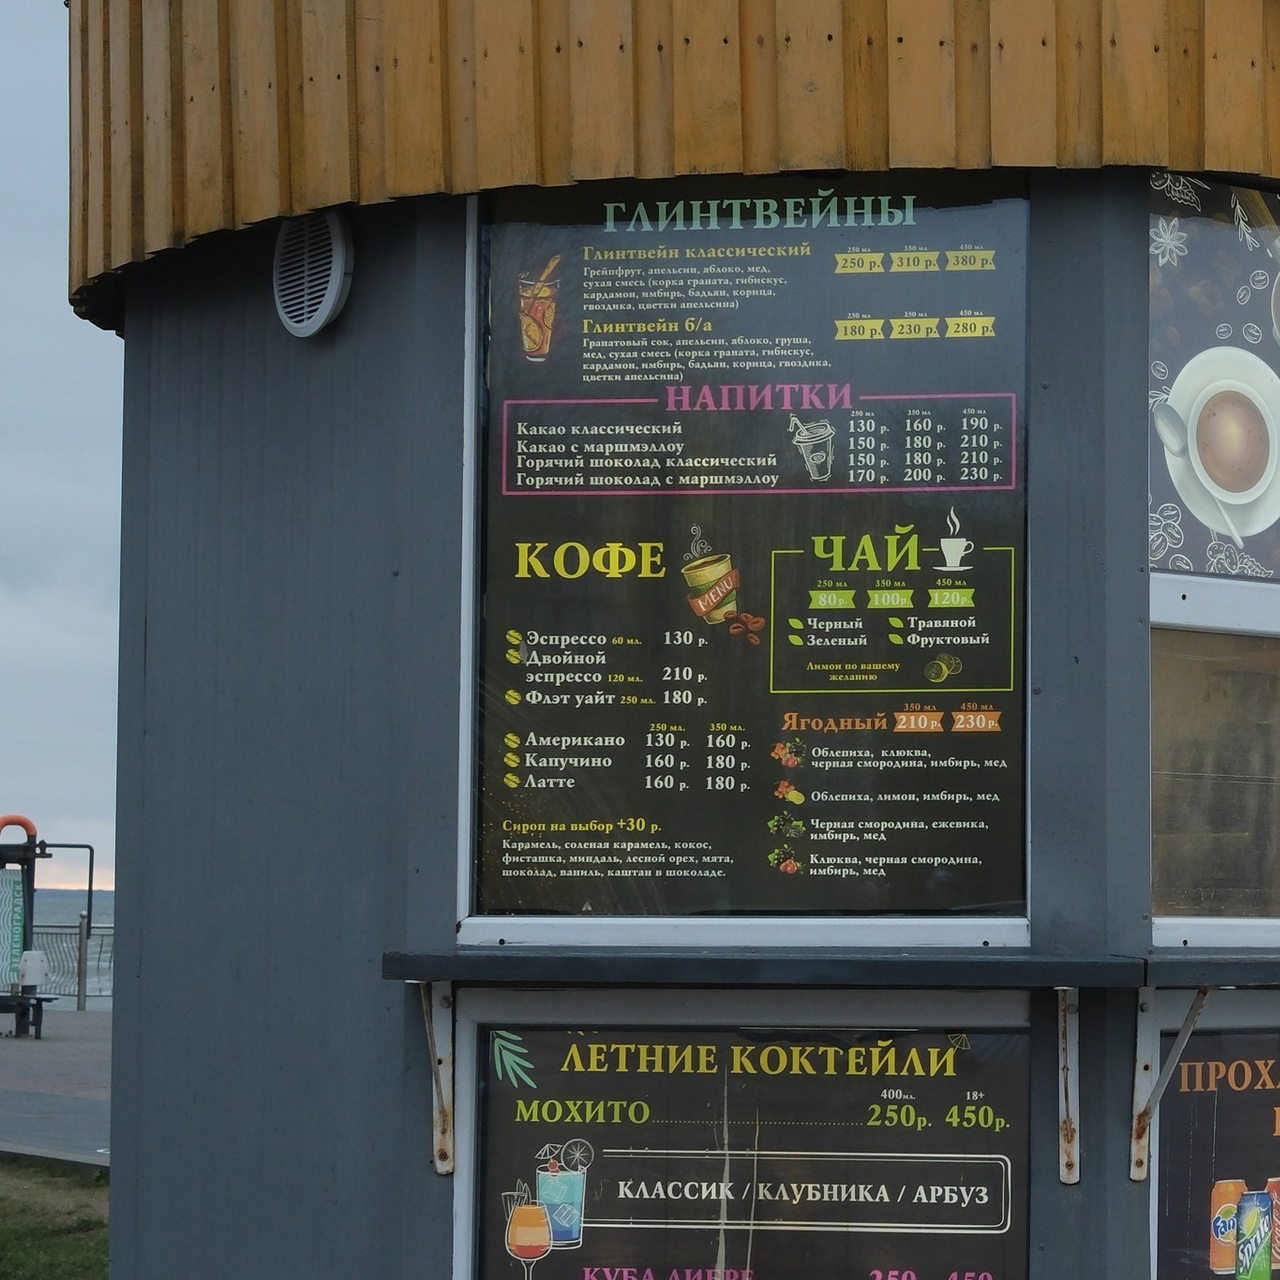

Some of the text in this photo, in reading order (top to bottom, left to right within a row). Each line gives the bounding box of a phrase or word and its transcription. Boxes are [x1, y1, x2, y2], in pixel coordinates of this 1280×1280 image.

[604, 189, 917, 232] ГЛИНТВЕЙНЫ
[583, 242, 811, 261] Глинтвейн классический
[841, 255, 976, 268] 250 310 380
[582, 317, 713, 334] Глинтвейн б/а
[843, 323, 977, 336] 180 230 280
[665, 383, 853, 411] НАПИТКИ
[517, 417, 988, 435] Какао классический 130 160 190
[517, 434, 988, 456] Какао с маршмэллоу 150 180 210
[517, 451, 988, 471] Горячий шоколад классический 150 180 210
[516, 467, 988, 488] Горячий шоколад с маршмэллоу 170 200 230
[811, 524, 921, 572] ЧАЙ
[515, 541, 666, 579] КОФЕ
[697, 577, 734, 611] MENU
[807, 618, 863, 631] Черный
[907, 616, 976, 629] Травяной
[526, 631, 606, 648] Эспрессо
[612, 636, 623, 645] 60
[664, 631, 693, 645] 130
[807, 634, 868, 647] Зеленый
[907, 633, 989, 647] Фруктовый
[526, 650, 606, 666] Двойной
[806, 662, 900, 672] Лимон по вашему
[525, 671, 602, 685] эспрессо
[608, 674, 624, 682] 120
[662, 667, 692, 681] 210
[829, 672, 877, 681] желанию
[525, 690, 571, 704] Флэт
[575, 691, 615, 708] уайт
[620, 696, 637, 704] 250
[663, 690, 692, 704] 180
[782, 712, 887, 733] Ягодный
[525, 732, 735, 749] Американо 130 160
[525, 753, 735, 770] Капучино 160 180
[811, 748, 931, 758] Облепиха, клюква,
[811, 757, 1007, 770] черная смородина, имбирь, мед
[524, 774, 735, 790] Латте 160 180
[811, 791, 1000, 803] Облепиха, лимон, имбирь, мед
[503, 818, 646, 834] Сироп на выбор +30
[811, 819, 989, 830] Черная смородина, ежевика,
[502, 840, 712, 850] Карамель, соленая карамель, кокос,
[560, 1039, 956, 1076] ЛЕТНИЕ КОКТЕЙЛИ
[965, 1091, 985, 1101] 18+
[515, 1099, 650, 1124] МОХИТО
[618, 1180, 989, 1207] КЛАССИК КЛУБНИКА АРБУЗ
[1239, 1215, 1272, 1274] Sprite
